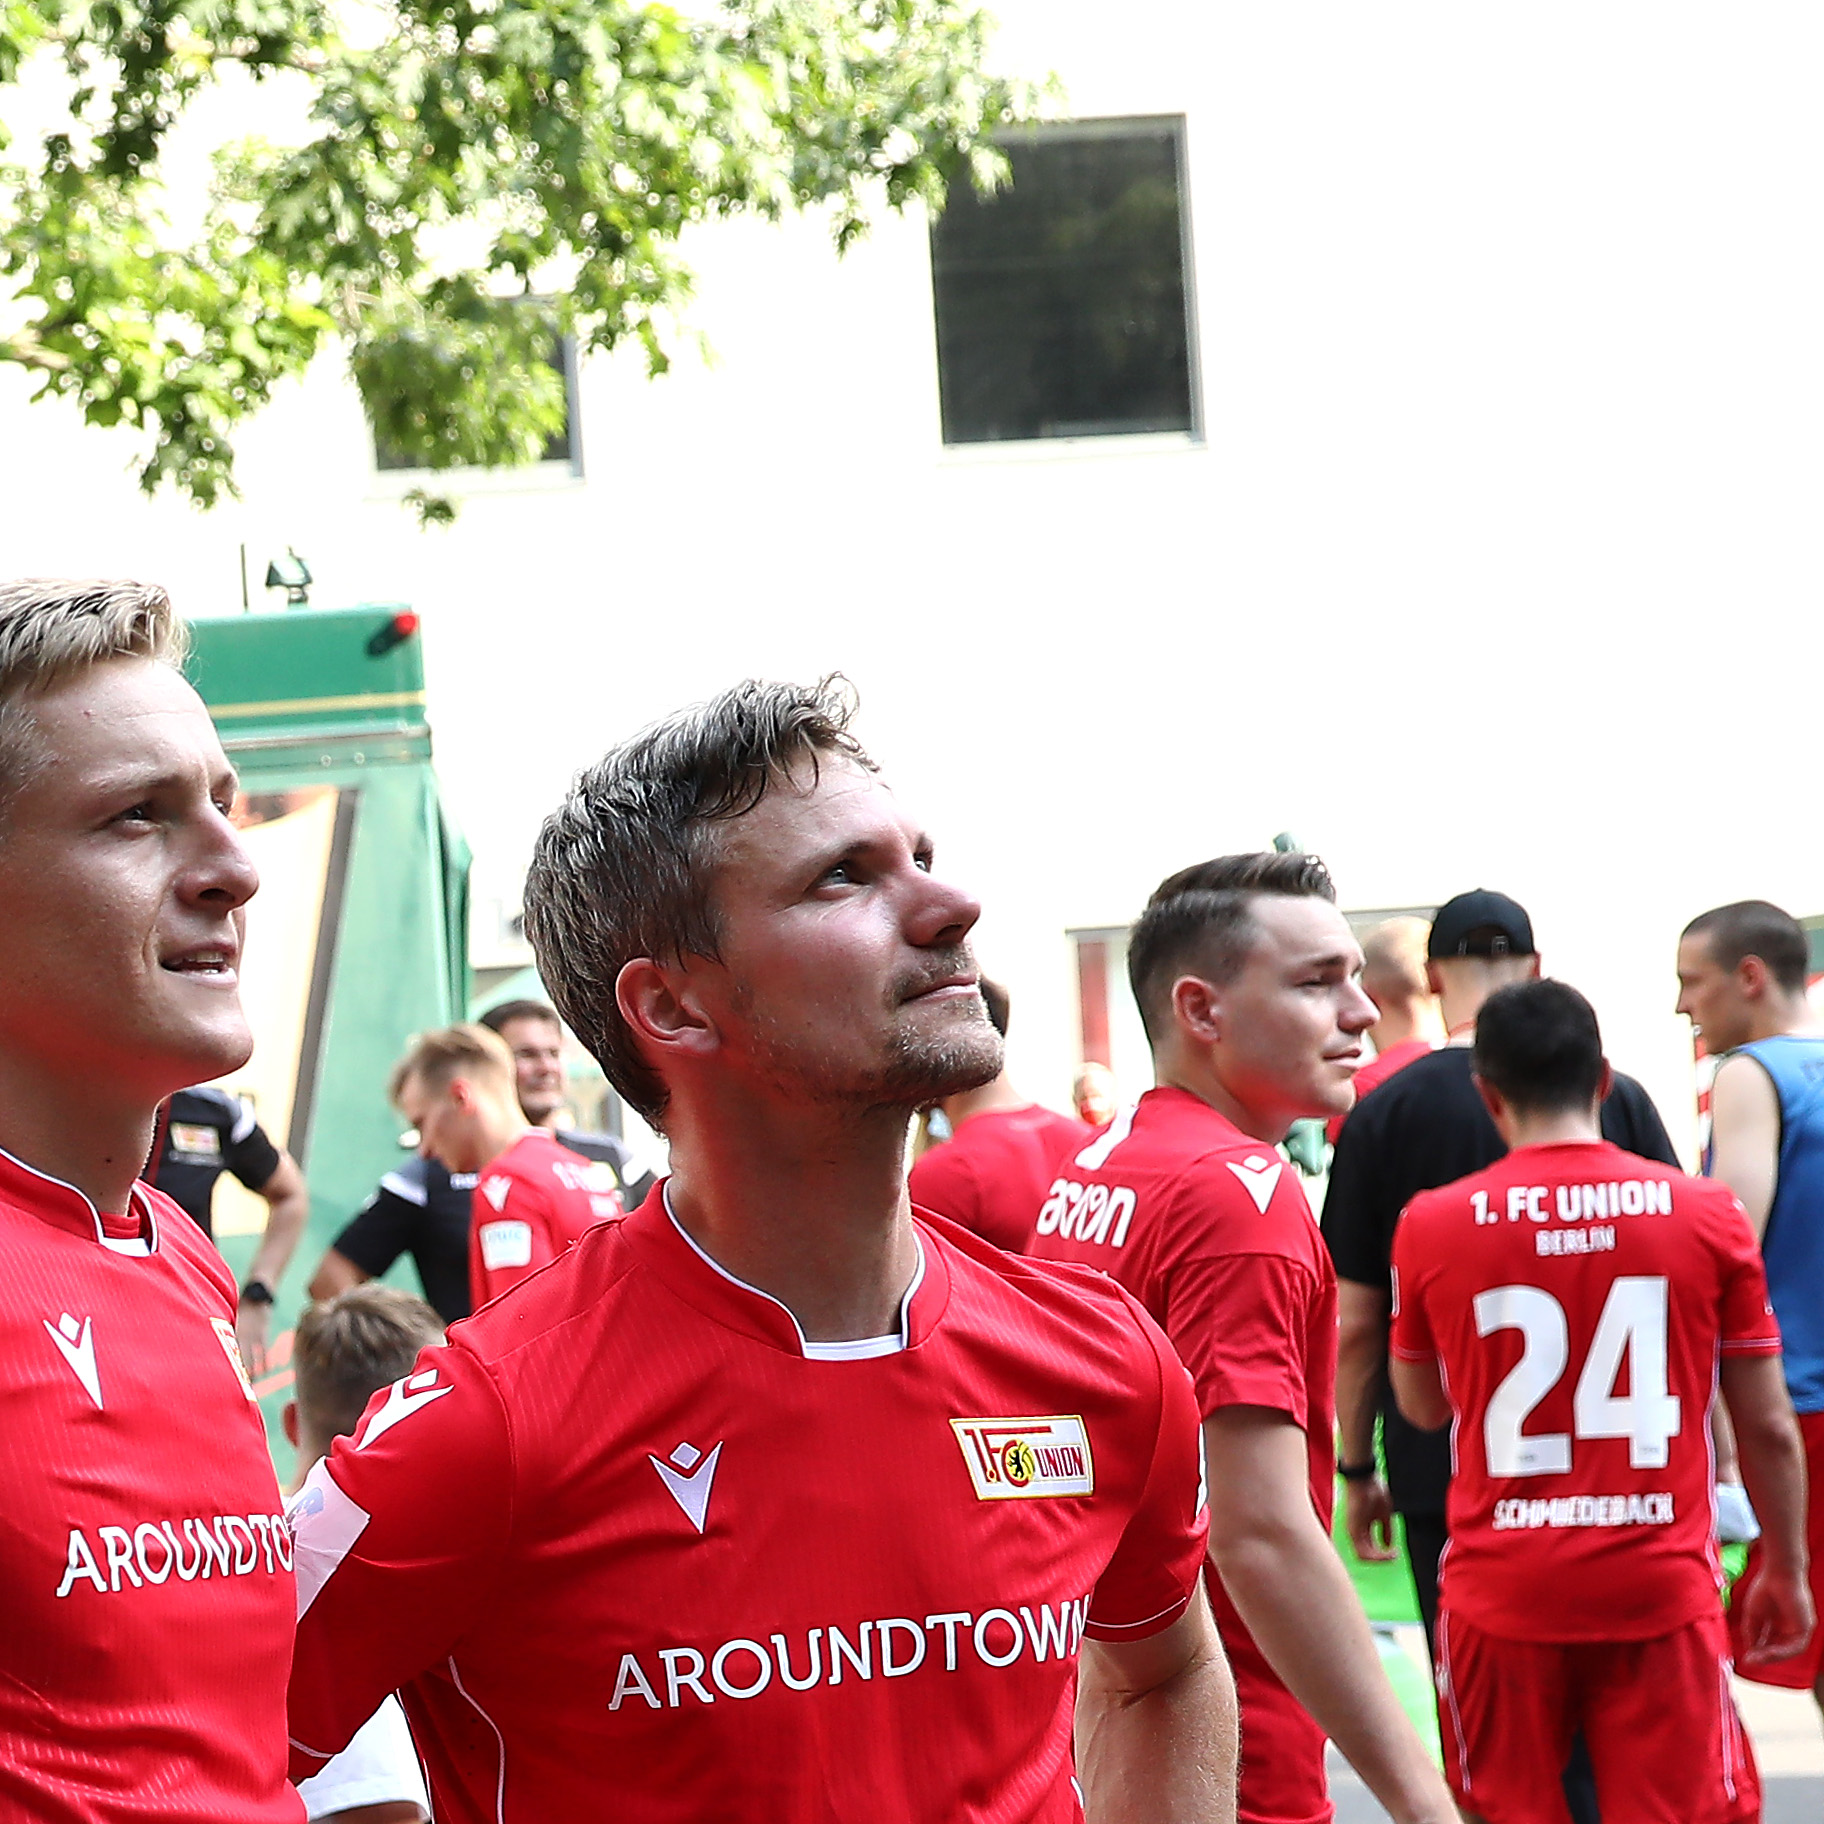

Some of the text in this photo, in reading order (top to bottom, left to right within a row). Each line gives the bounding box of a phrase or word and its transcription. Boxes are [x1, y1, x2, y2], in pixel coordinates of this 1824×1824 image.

[1470, 1180, 1672, 1226] 1. FC UNION
[1536, 1225, 1616, 1256] BERLIN
[1473, 1276, 1681, 1478] 24
[1034, 1446, 1084, 1478] UNION
[56, 1514, 294, 1598] AROUNDTO
